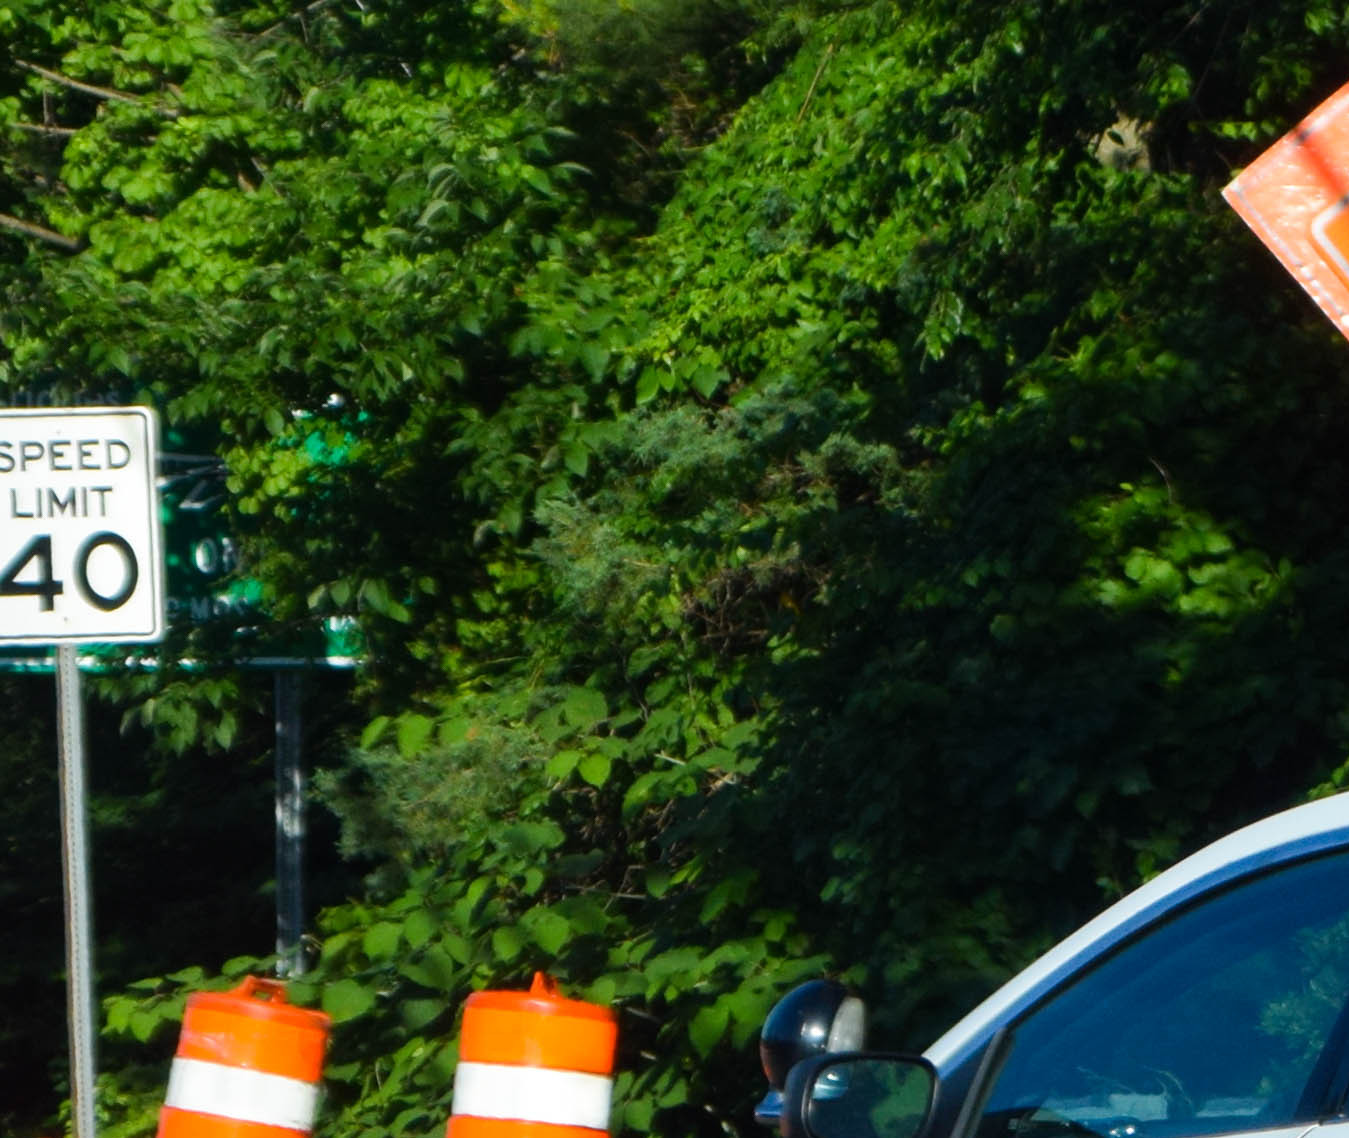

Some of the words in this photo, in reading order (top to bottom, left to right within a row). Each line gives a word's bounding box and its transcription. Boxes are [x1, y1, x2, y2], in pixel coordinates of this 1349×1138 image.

[0, 439, 131, 472] SPEED
[10, 486, 113, 518] LIMIT
[0, 530, 139, 612] 40
